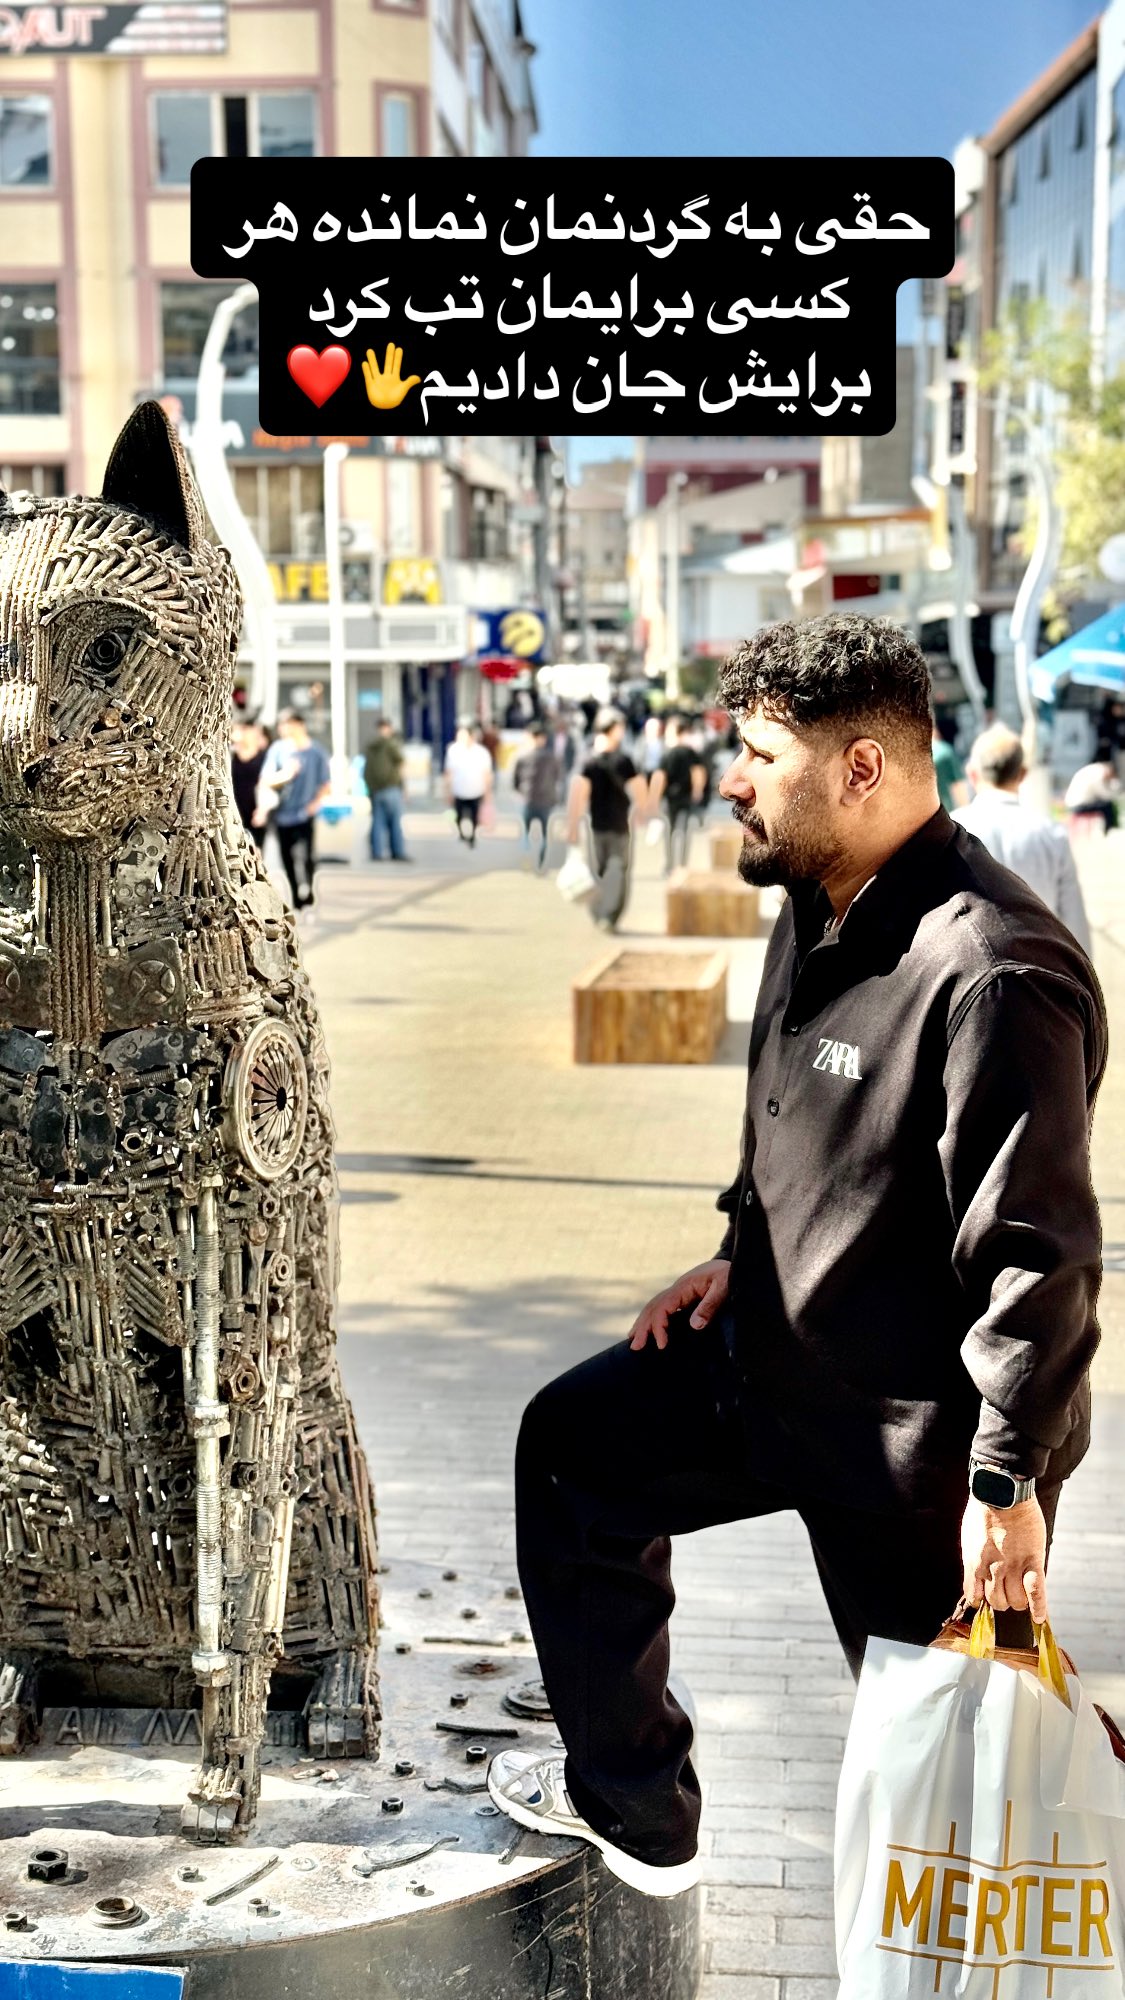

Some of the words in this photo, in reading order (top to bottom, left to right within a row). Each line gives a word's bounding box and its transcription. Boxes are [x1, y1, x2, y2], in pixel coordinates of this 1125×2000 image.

[267, 562, 328, 601] AFE
[812, 1037, 863, 1080] ZARA
[881, 1859, 1113, 1957] MERTER
